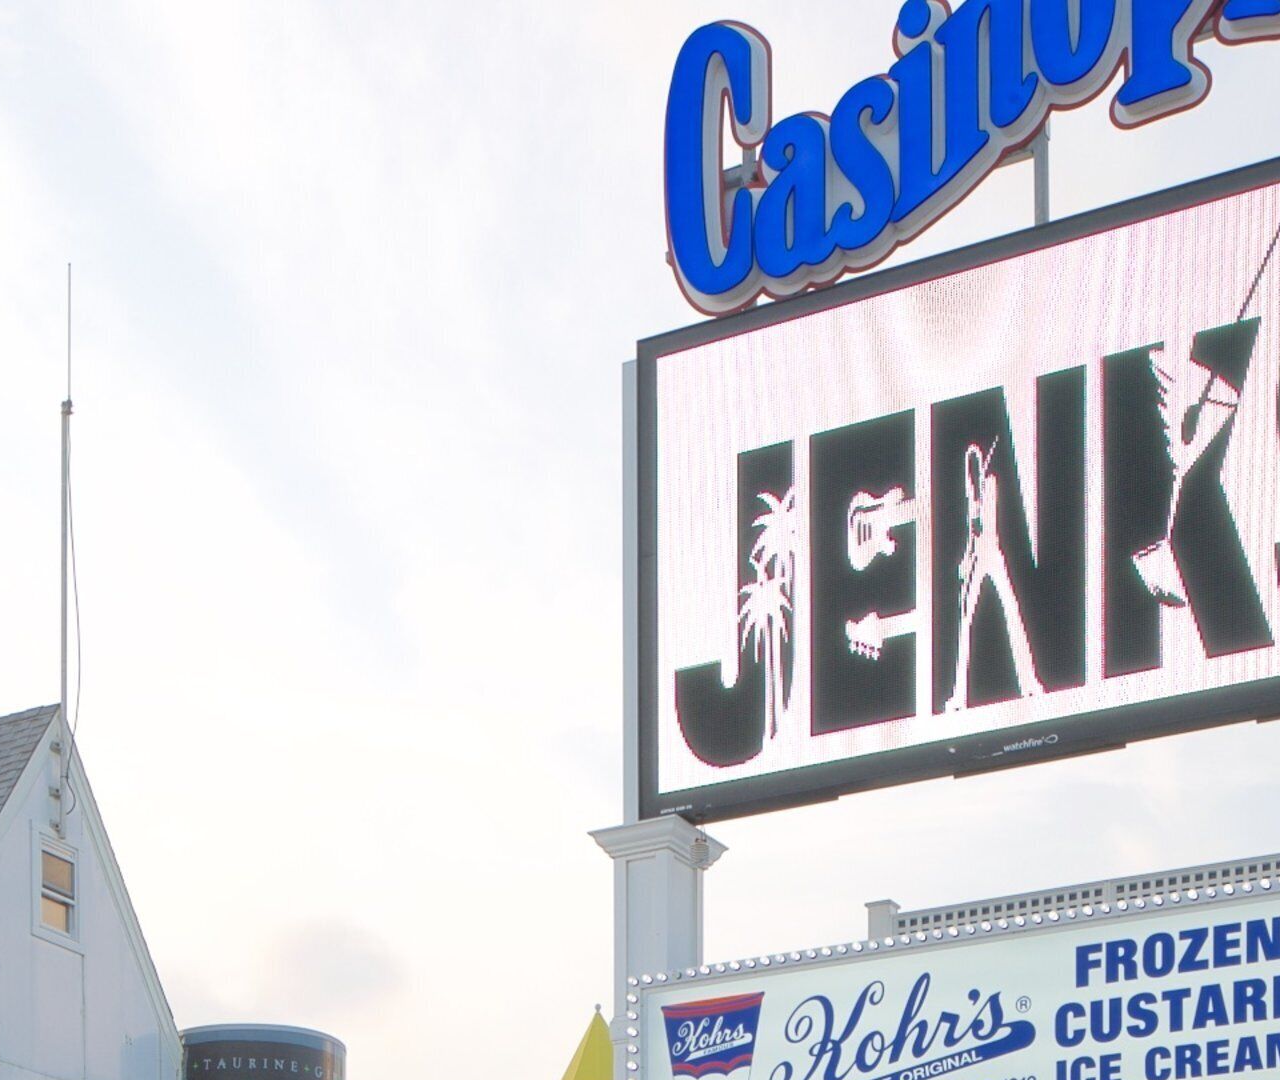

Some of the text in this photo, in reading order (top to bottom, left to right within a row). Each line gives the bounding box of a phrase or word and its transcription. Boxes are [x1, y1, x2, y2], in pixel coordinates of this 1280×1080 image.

[1003, 738, 1043, 753] watchfire
[672, 1015, 743, 1056] Kohrs
[203, 1057, 300, 1072] TAURINE
